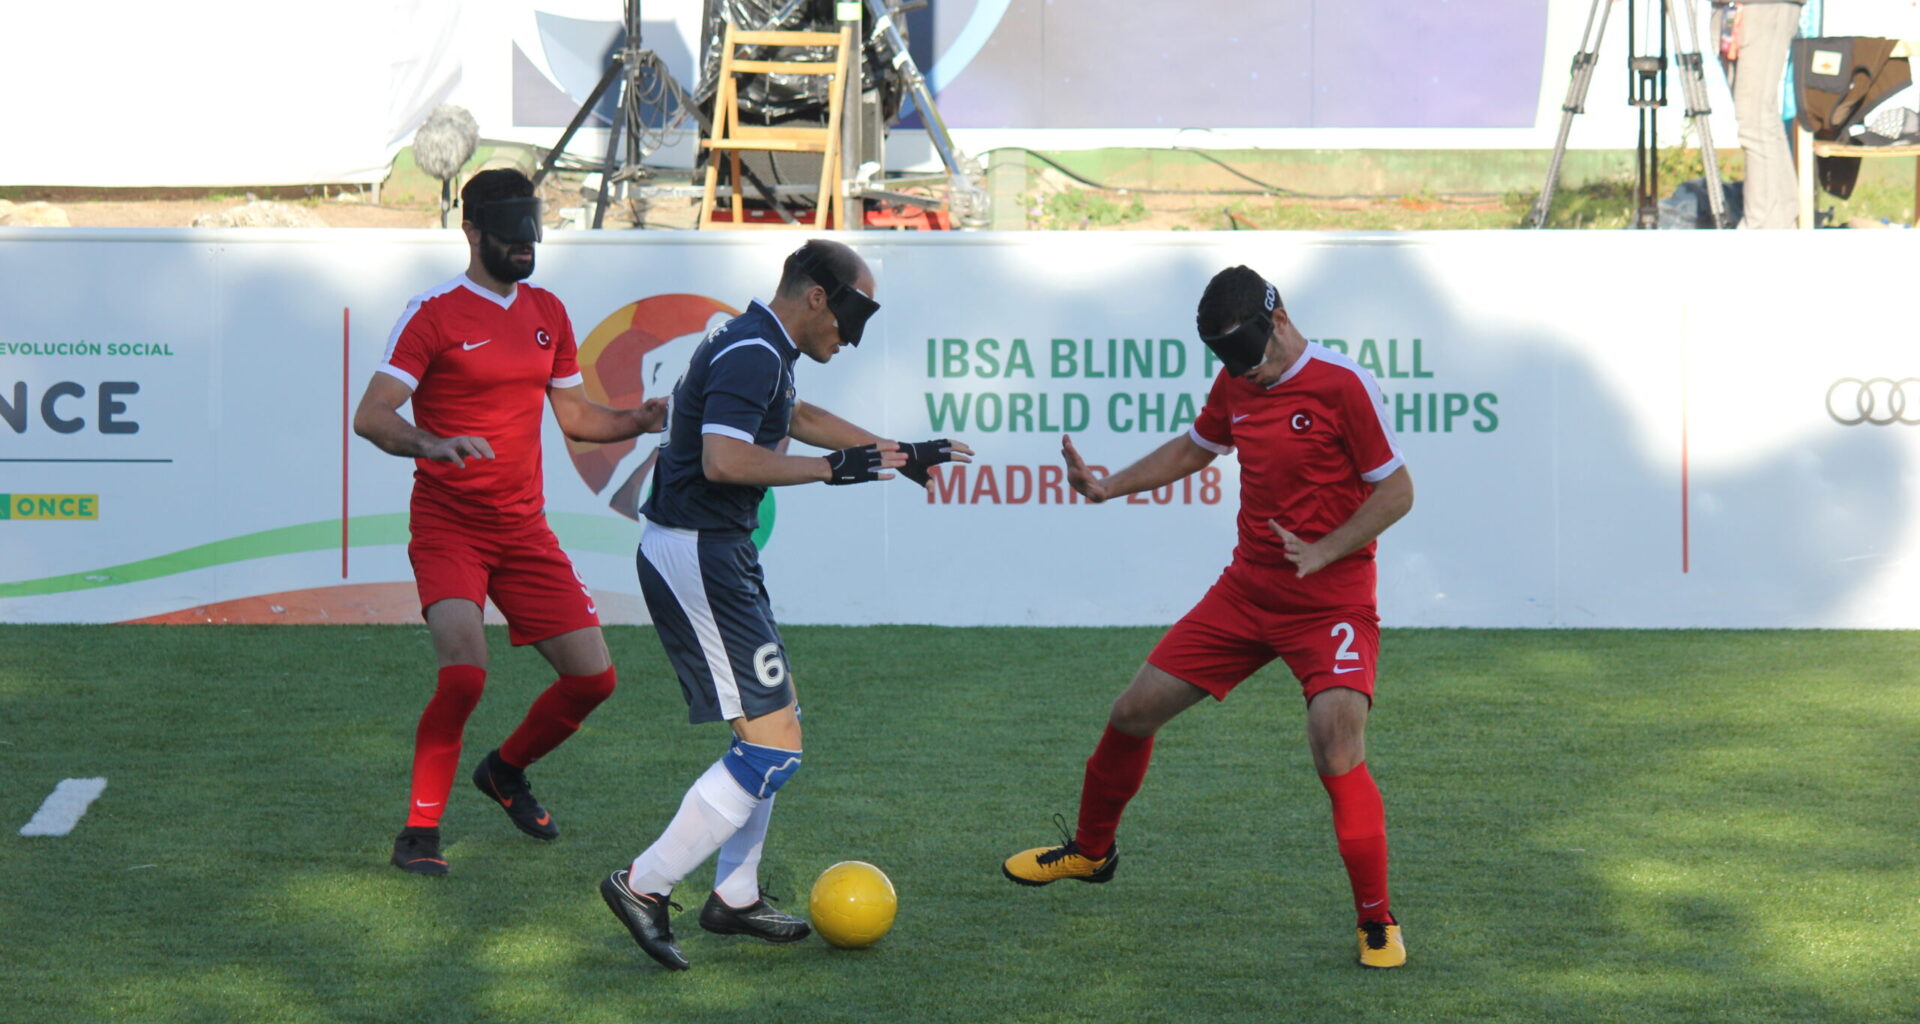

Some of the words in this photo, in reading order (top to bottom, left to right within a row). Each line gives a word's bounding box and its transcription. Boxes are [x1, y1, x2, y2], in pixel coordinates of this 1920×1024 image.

[107, 343, 174, 356] SOCIAL
[927, 338, 1035, 378] IBSA
[1051, 338, 1187, 378] BLIND
[924, 392, 1090, 433] WORLD
[17, 498, 94, 517] ONCE
[1330, 621, 1360, 661] 2
[753, 642, 786, 688] 6
